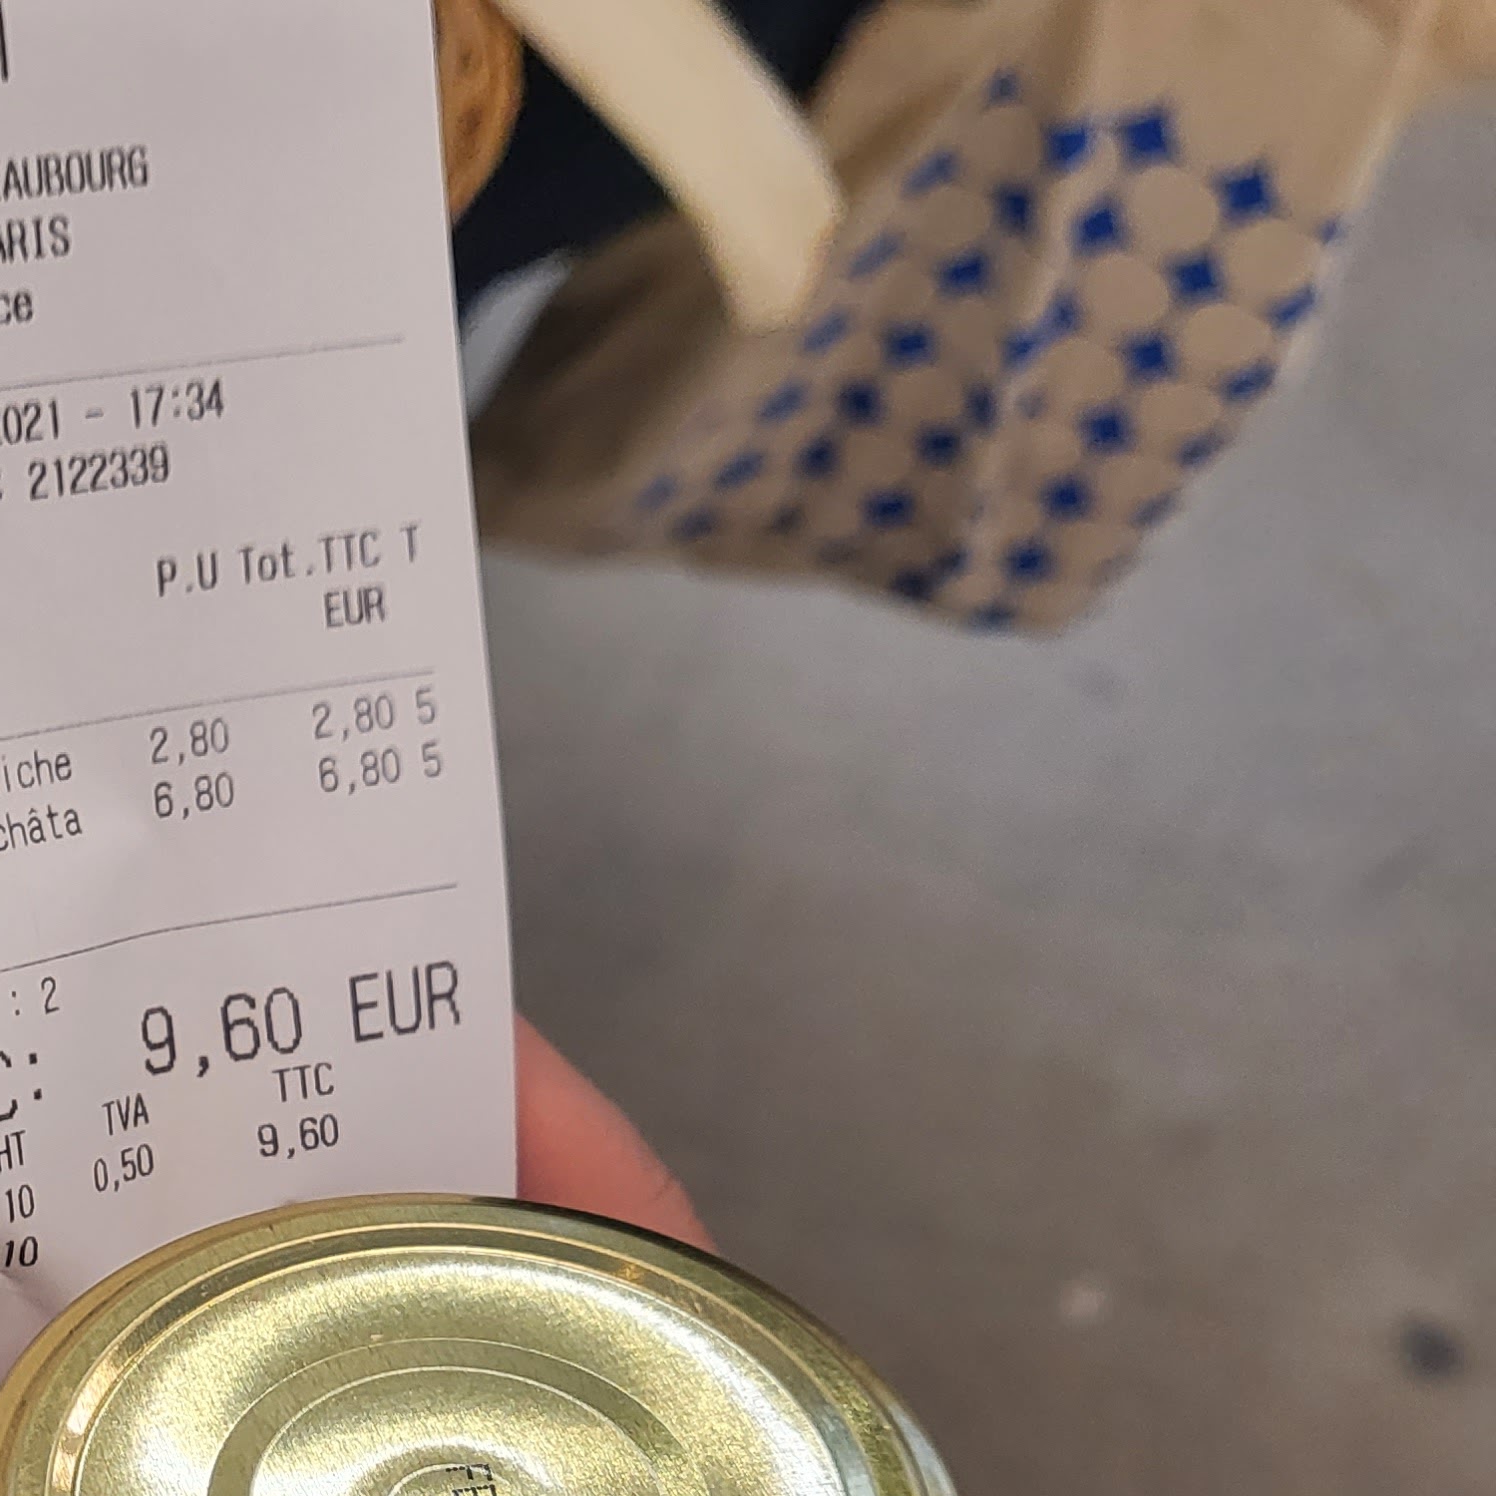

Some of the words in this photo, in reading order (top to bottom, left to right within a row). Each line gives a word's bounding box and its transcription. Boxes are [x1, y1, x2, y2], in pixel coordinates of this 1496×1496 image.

[131, 379, 224, 429] 17:34
[28, 445, 169, 501] 2122339
[157, 552, 217, 597] P.U
[239, 531, 380, 584] Tot.TTC
[400, 524, 417, 562] T
[324, 587, 385, 628] EUR
[147, 712, 229, 765] 2,80
[312, 694, 395, 742] 2,80
[416, 687, 437, 725] 5
[154, 772, 234, 820] 6,80
[319, 748, 401, 795] 6,80
[422, 740, 443, 778] 5
[41, 976, 59, 1014] 2
[141, 987, 302, 1077] 9,60
[349, 961, 460, 1043] EUR
[102, 1093, 149, 1135] TVA
[272, 1063, 334, 1102] TTC
[94, 1144, 154, 1192] 0,50
[258, 1114, 338, 1159] 9,60
